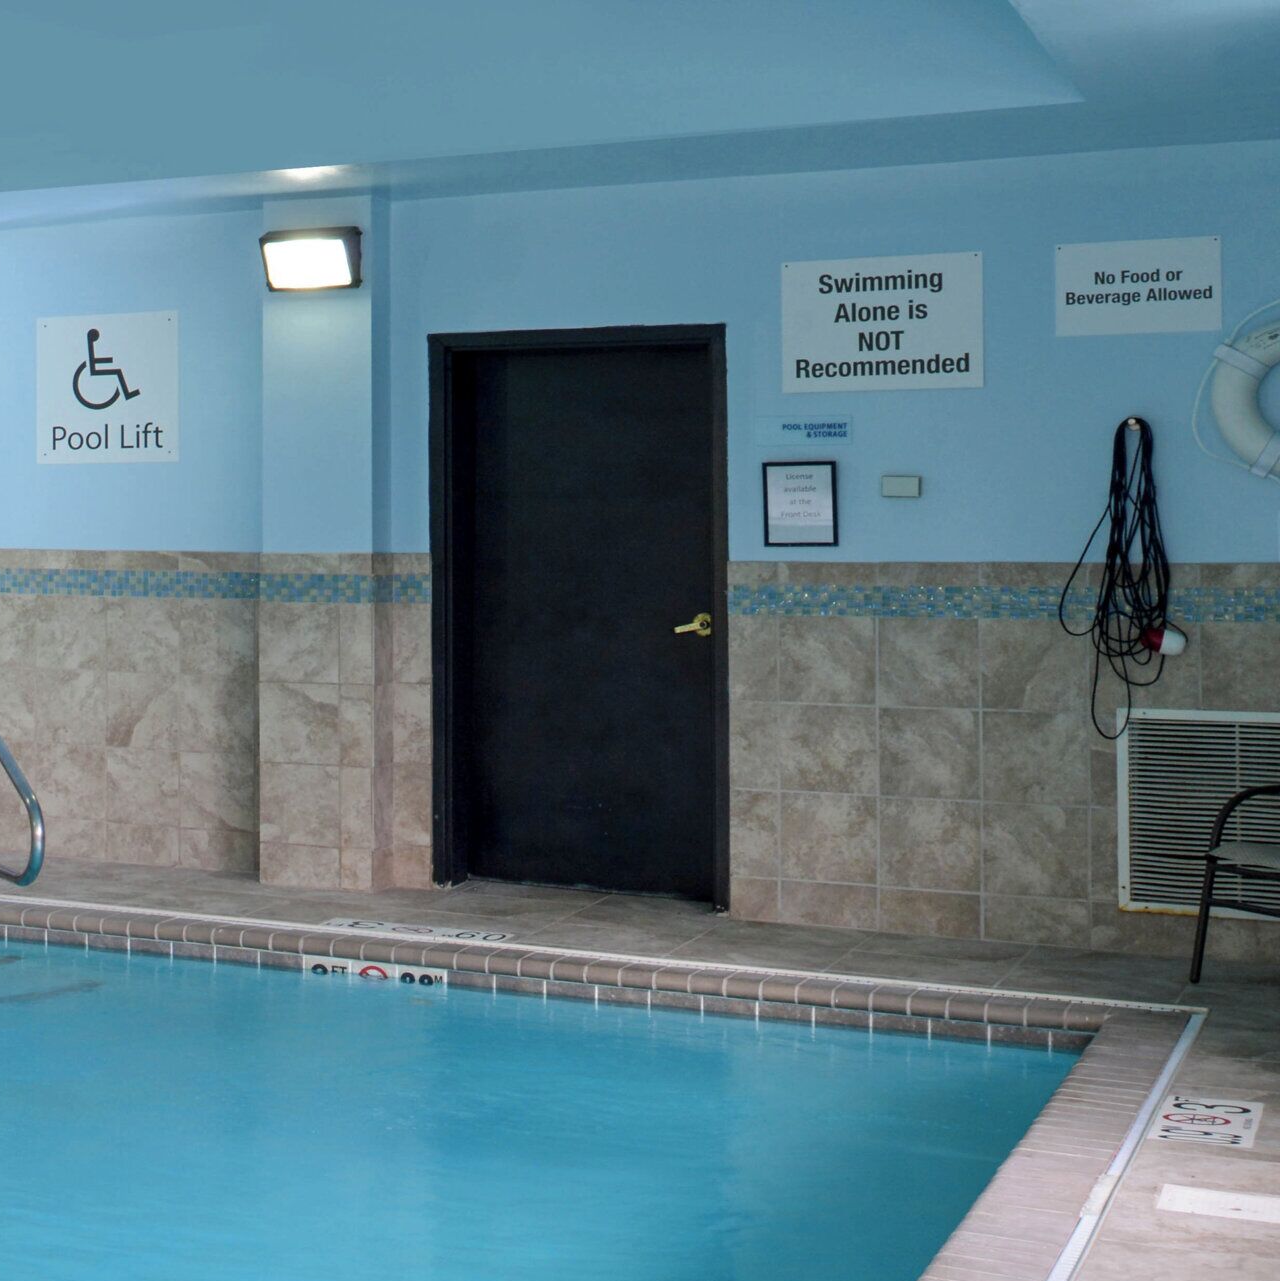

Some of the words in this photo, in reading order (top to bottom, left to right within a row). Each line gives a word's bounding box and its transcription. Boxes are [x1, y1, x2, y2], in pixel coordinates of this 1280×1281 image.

[818, 269, 944, 295] Swimming
[1094, 271, 1116, 285] No
[1120, 268, 1160, 284] Food
[1165, 269, 1184, 282] or
[1065, 290, 1141, 306] Beverage
[1146, 285, 1213, 302] Allowed
[834, 302, 900, 324] Alone
[908, 299, 928, 320] is
[858, 330, 905, 352] NOT
[795, 352, 970, 379] Recommended
[52, 423, 109, 451] Pool
[120, 422, 164, 449] Lift
[782, 423, 803, 431] POOL
[804, 422, 848, 431] EQUIPMENT
[813, 430, 848, 438] STORAGE
